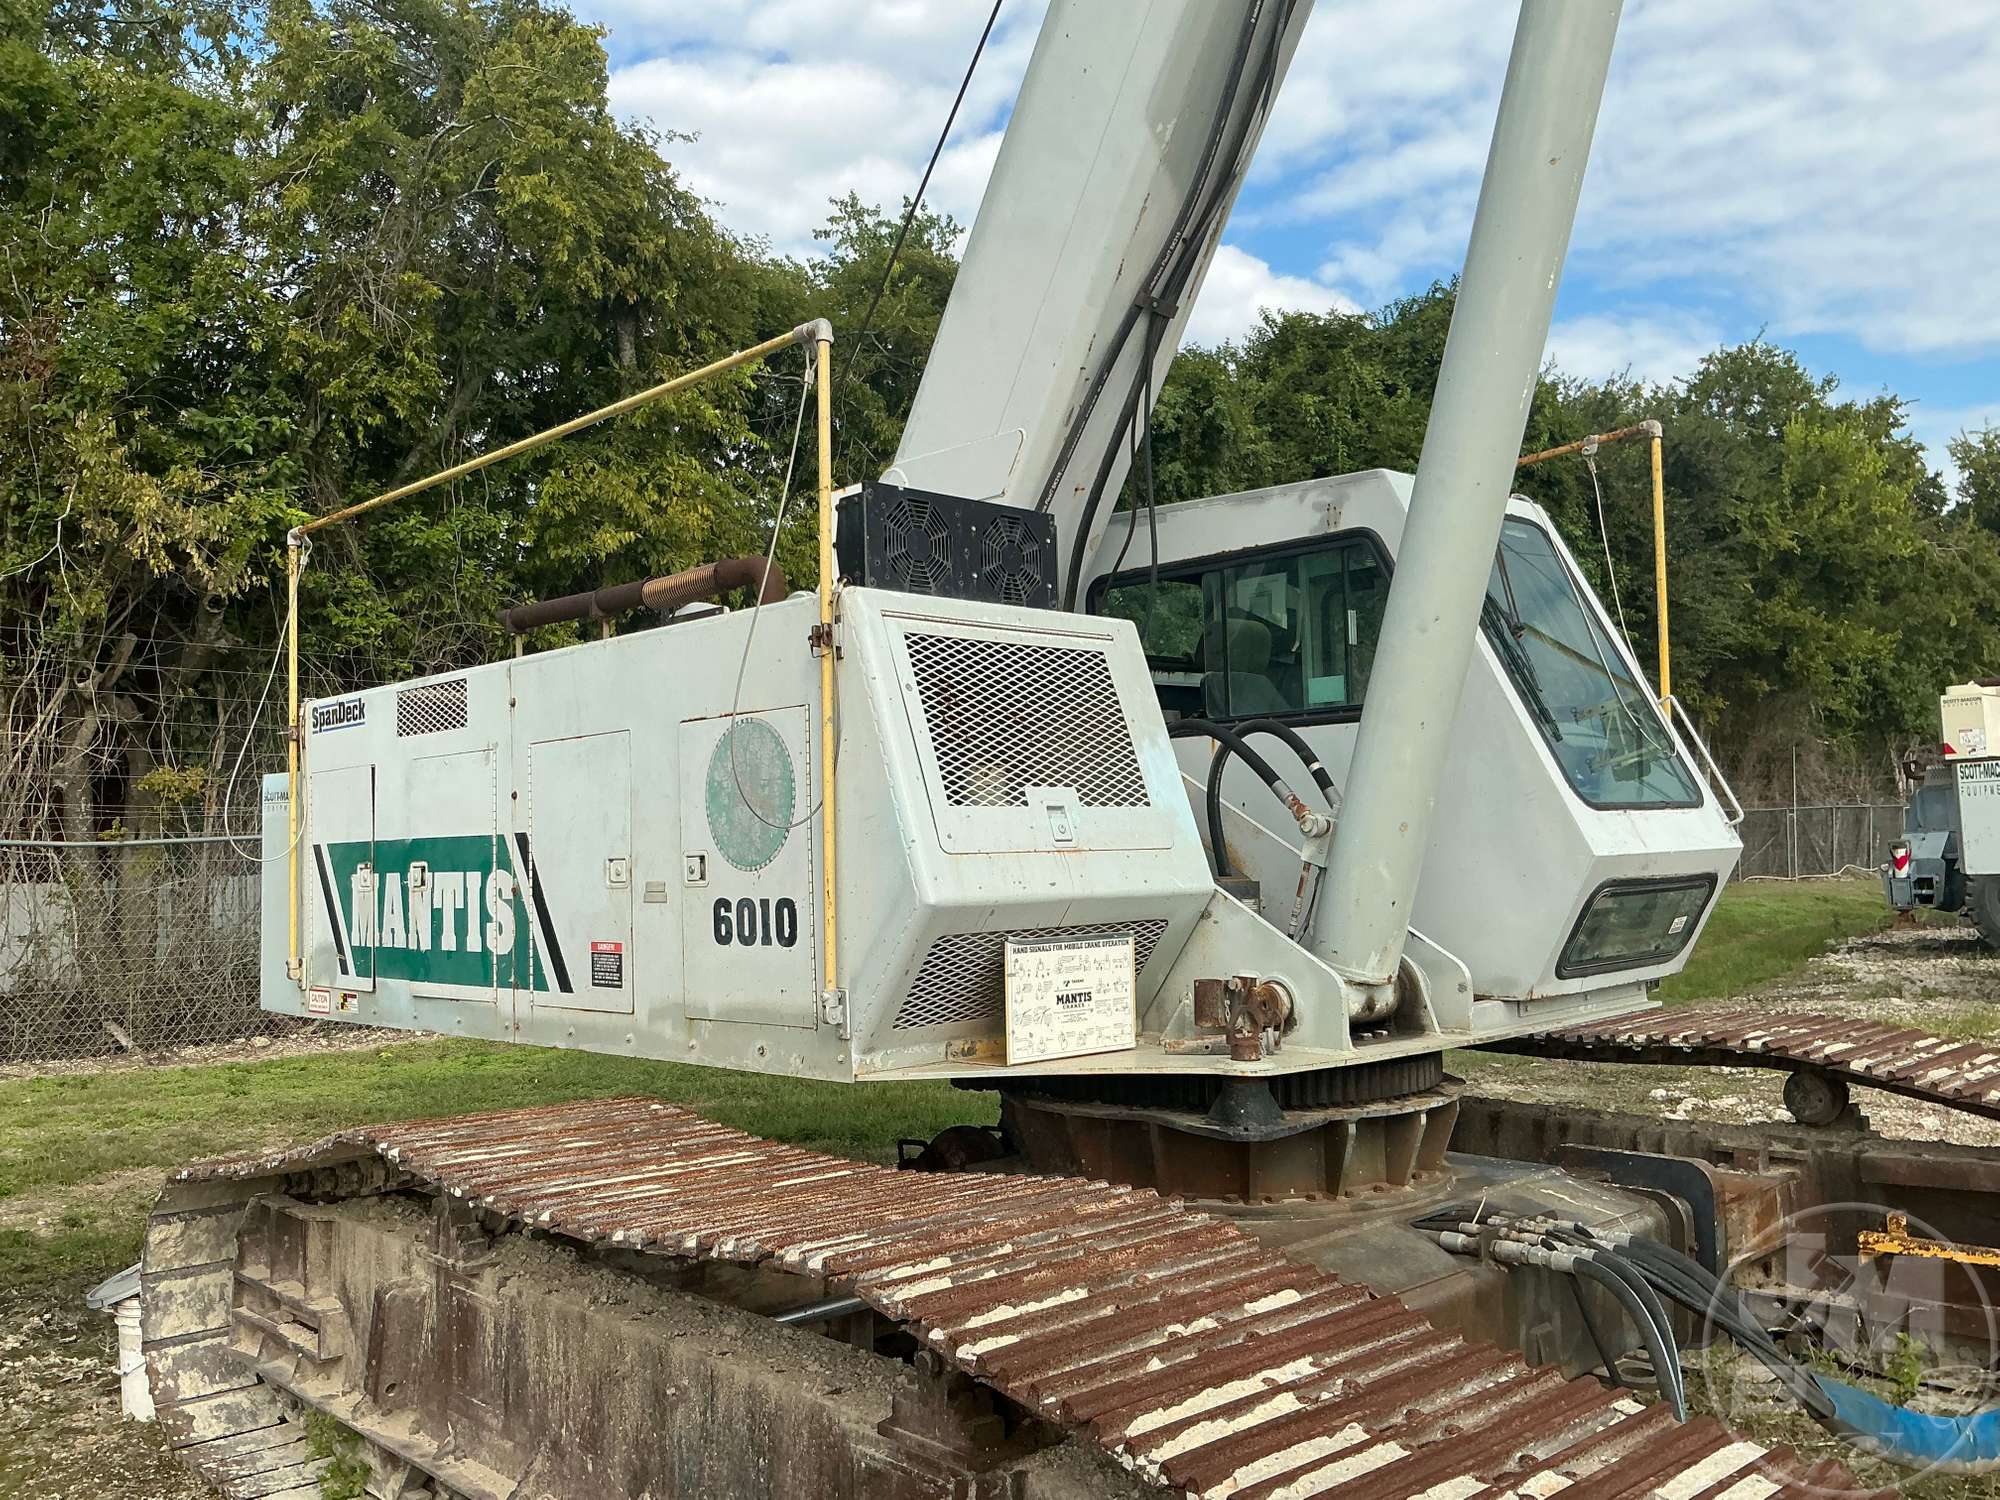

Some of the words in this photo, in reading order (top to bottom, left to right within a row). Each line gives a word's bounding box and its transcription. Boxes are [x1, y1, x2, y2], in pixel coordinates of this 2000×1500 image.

[312, 697, 365, 733] SpanDeck
[351, 868, 516, 956] MANTIS
[712, 896, 798, 948] 6010
[1013, 947, 1028, 955] HAND
[1029, 945, 1052, 953] SIGNALS
[1053, 944, 1063, 952] FOR
[1064, 942, 1083, 951] MOBILE
[1084, 941, 1101, 949] CRANE
[1056, 991, 1092, 1005] MANTIS
